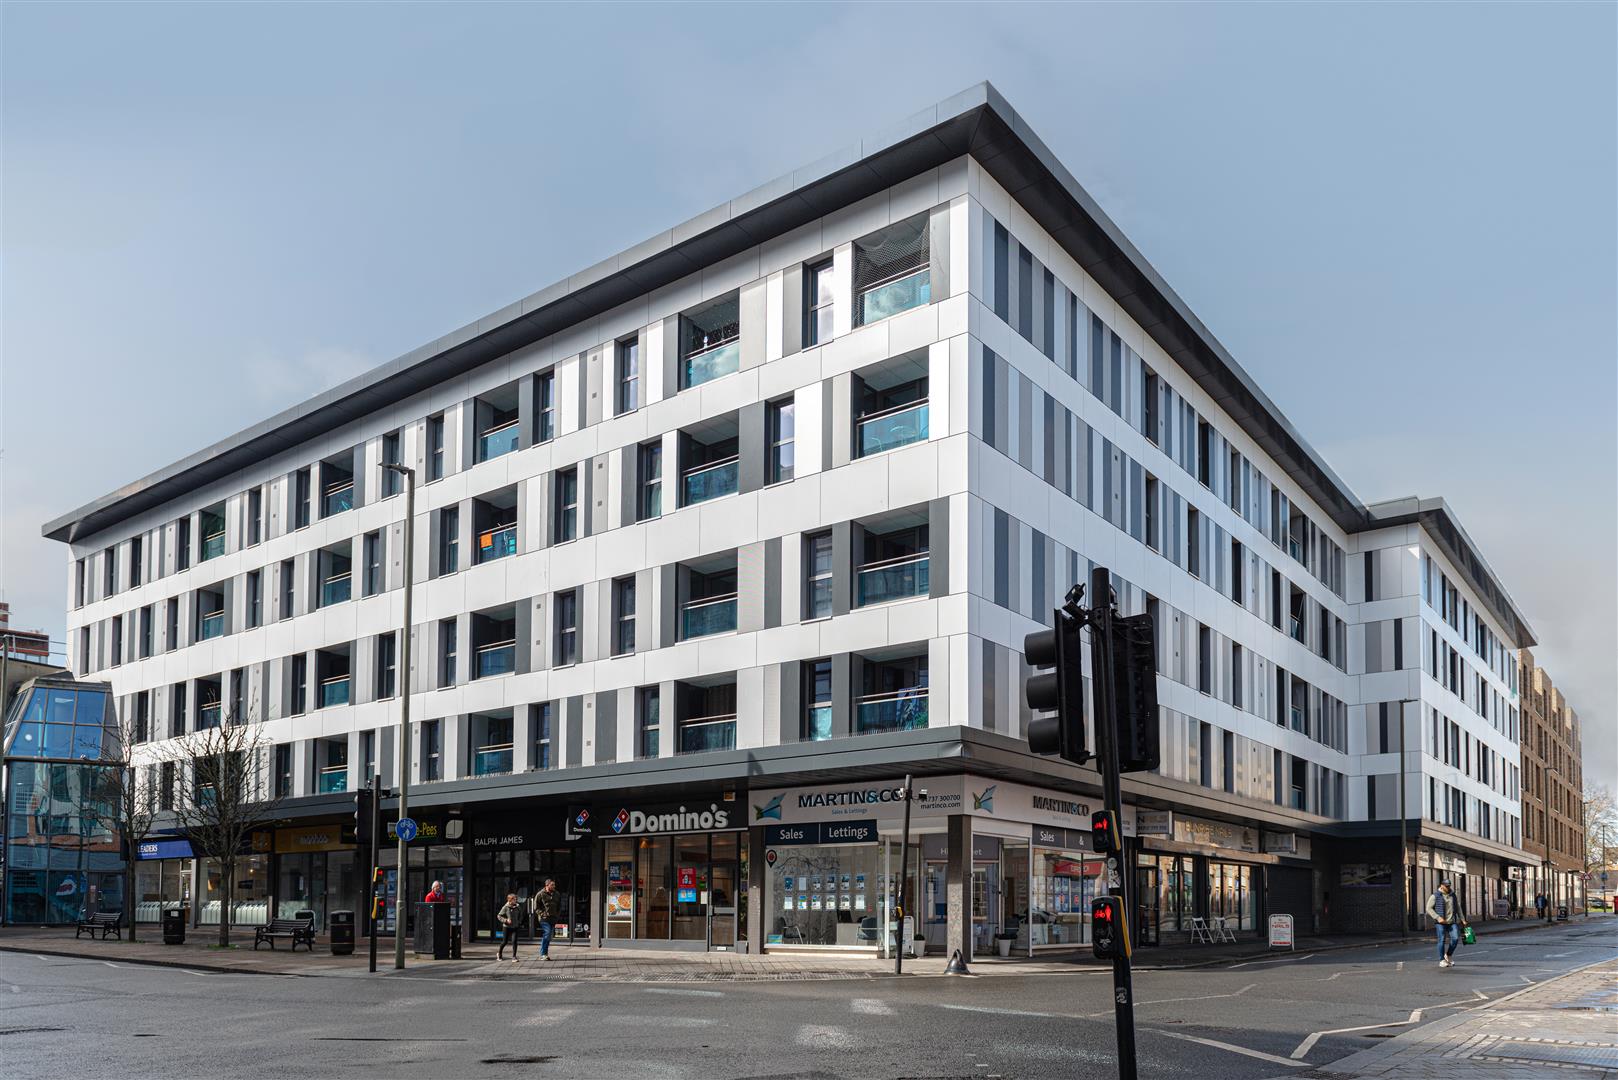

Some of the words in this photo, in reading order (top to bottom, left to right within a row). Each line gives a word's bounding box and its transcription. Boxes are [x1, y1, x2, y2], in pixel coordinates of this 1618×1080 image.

[1032, 795, 1090, 816] MARTIN&CO
[630, 803, 728, 832] Domino's
[780, 829, 803, 840] Sales
[828, 826, 868, 839] Lettings
[1040, 831, 1054, 842] Sales
[1078, 836, 1084, 846] &
[474, 838, 497, 846] RALPH
[499, 836, 523, 845] JAMES
